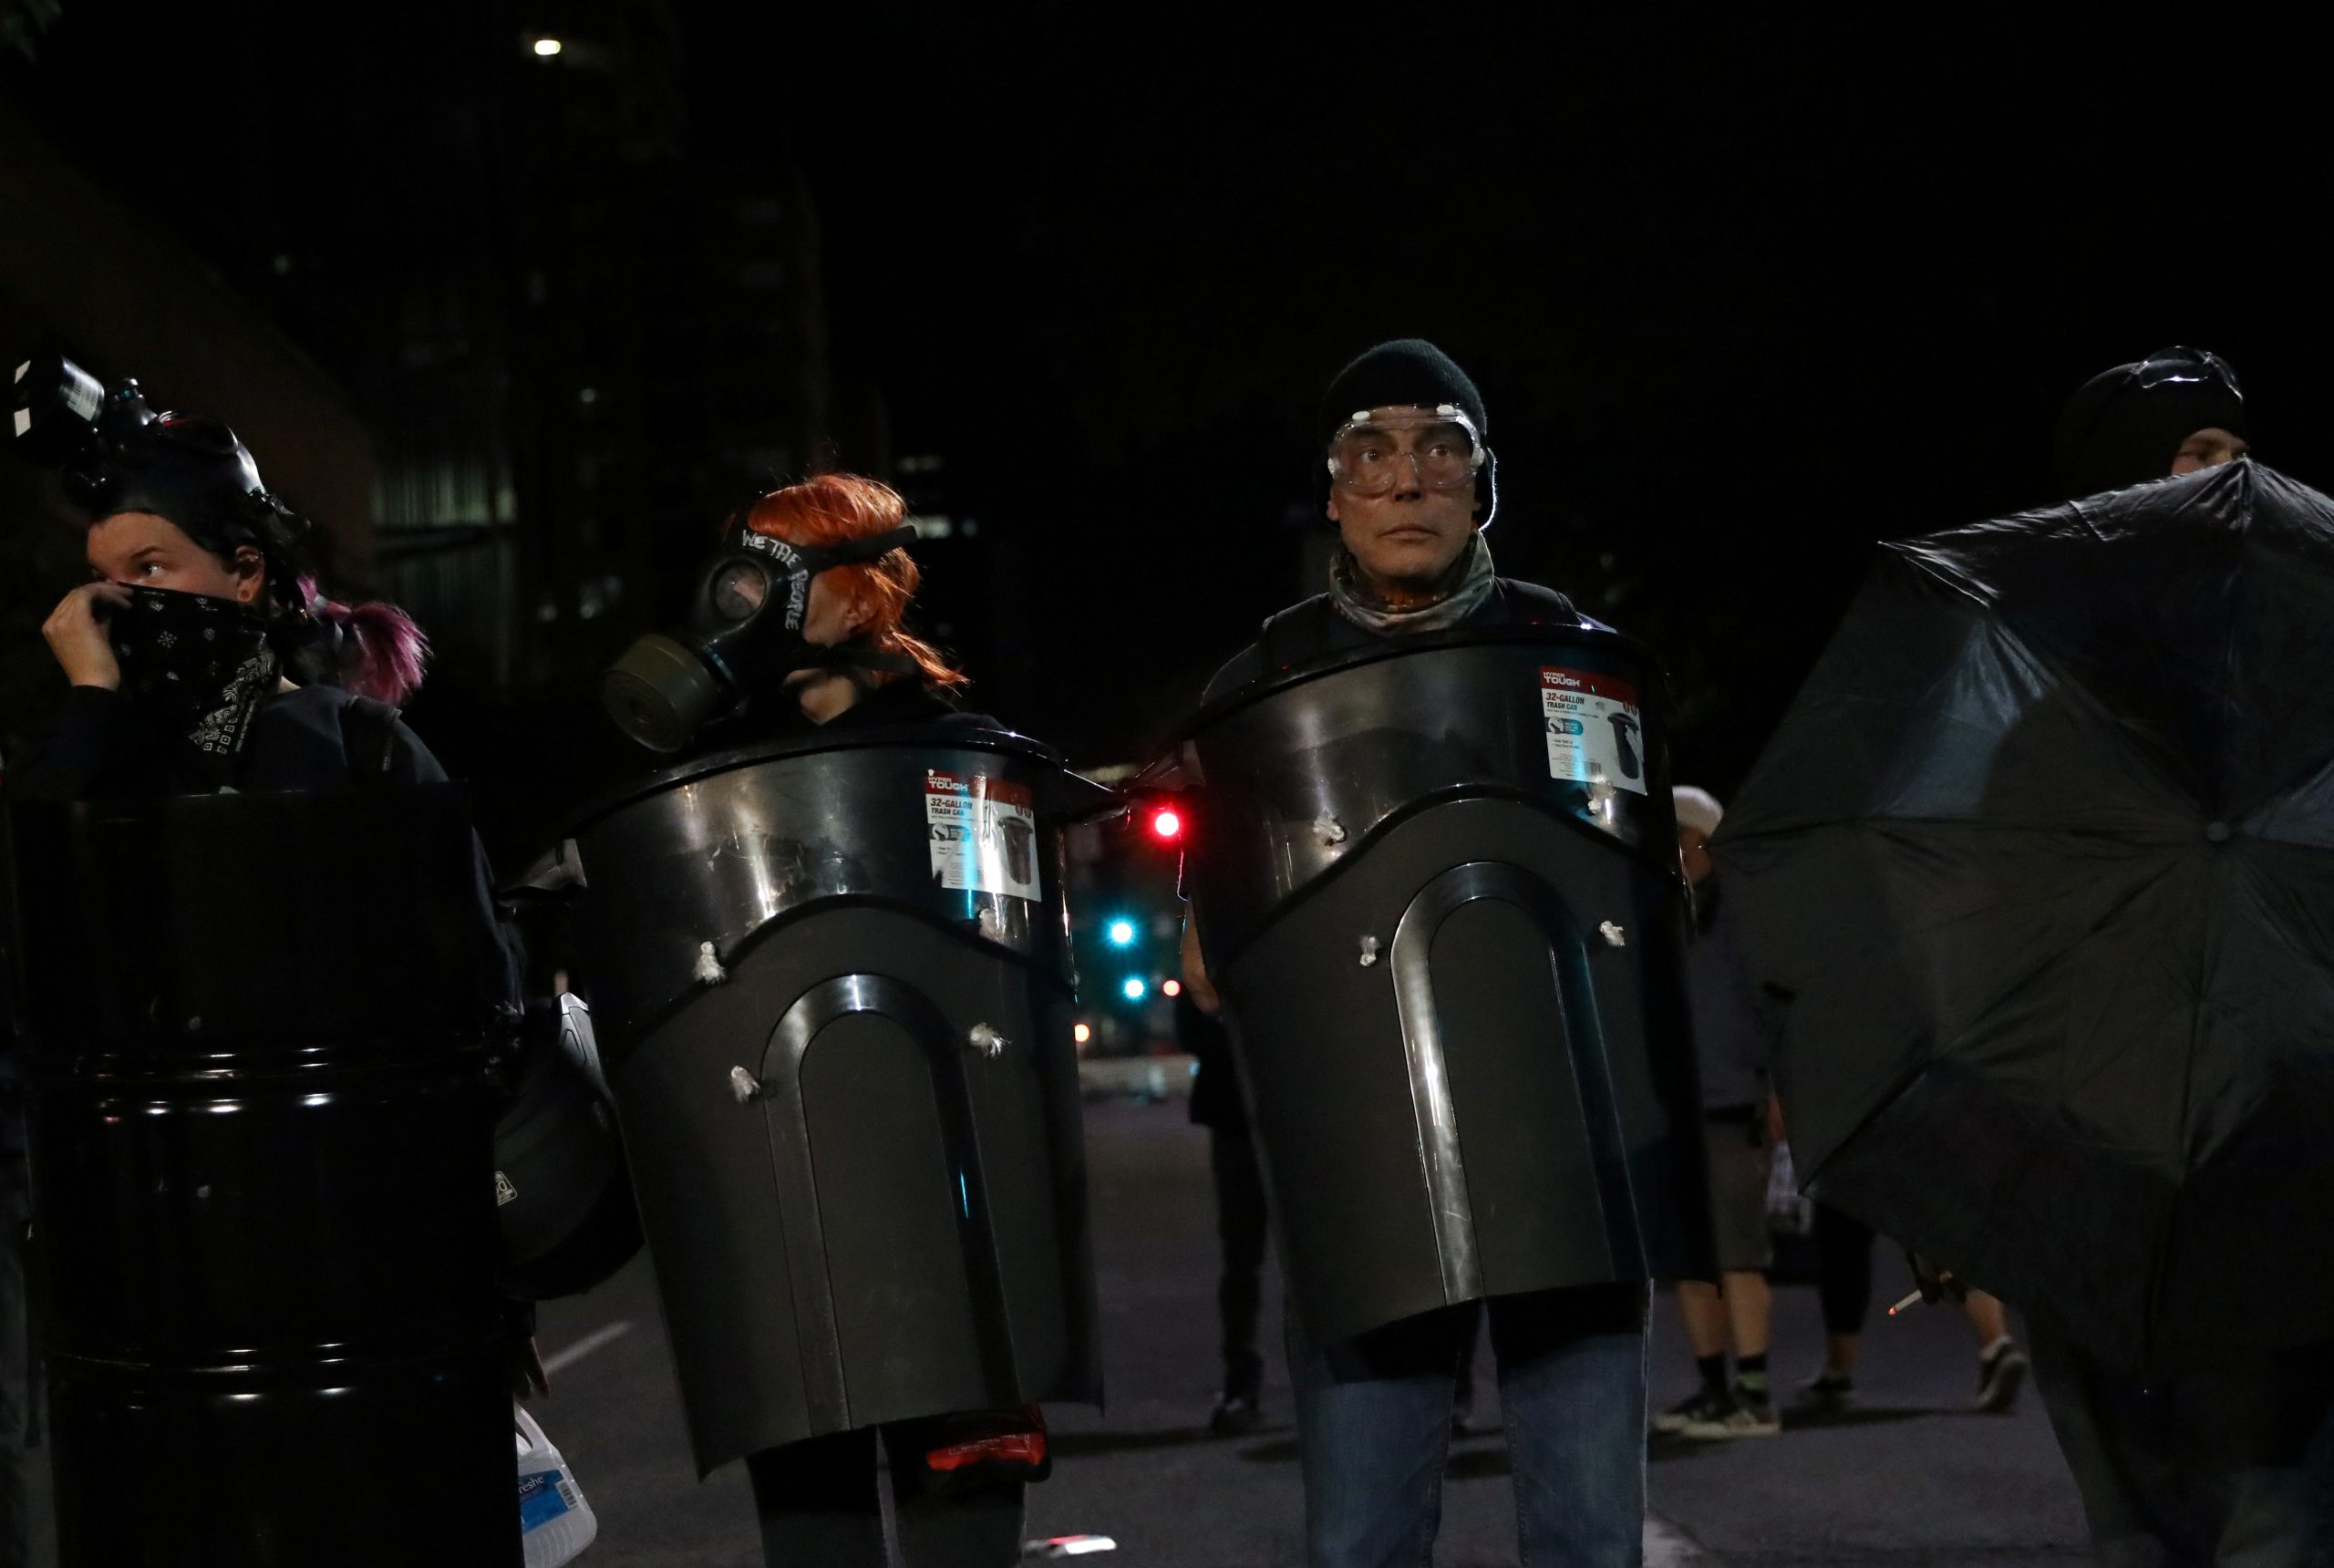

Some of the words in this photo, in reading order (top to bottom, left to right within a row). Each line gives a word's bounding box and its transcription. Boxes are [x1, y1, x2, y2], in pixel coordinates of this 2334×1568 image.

[742, 530, 769, 549] WE
[769, 539, 801, 569] THE
[784, 569, 810, 630] PEOPLE
[1544, 676, 1580, 686] TOUGH
[1546, 693, 1585, 705] 32-GALLON
[929, 781, 968, 791] TOUGH
[931, 798, 973, 810] 32-GALLON
[518, 1475, 544, 1494] reshe
